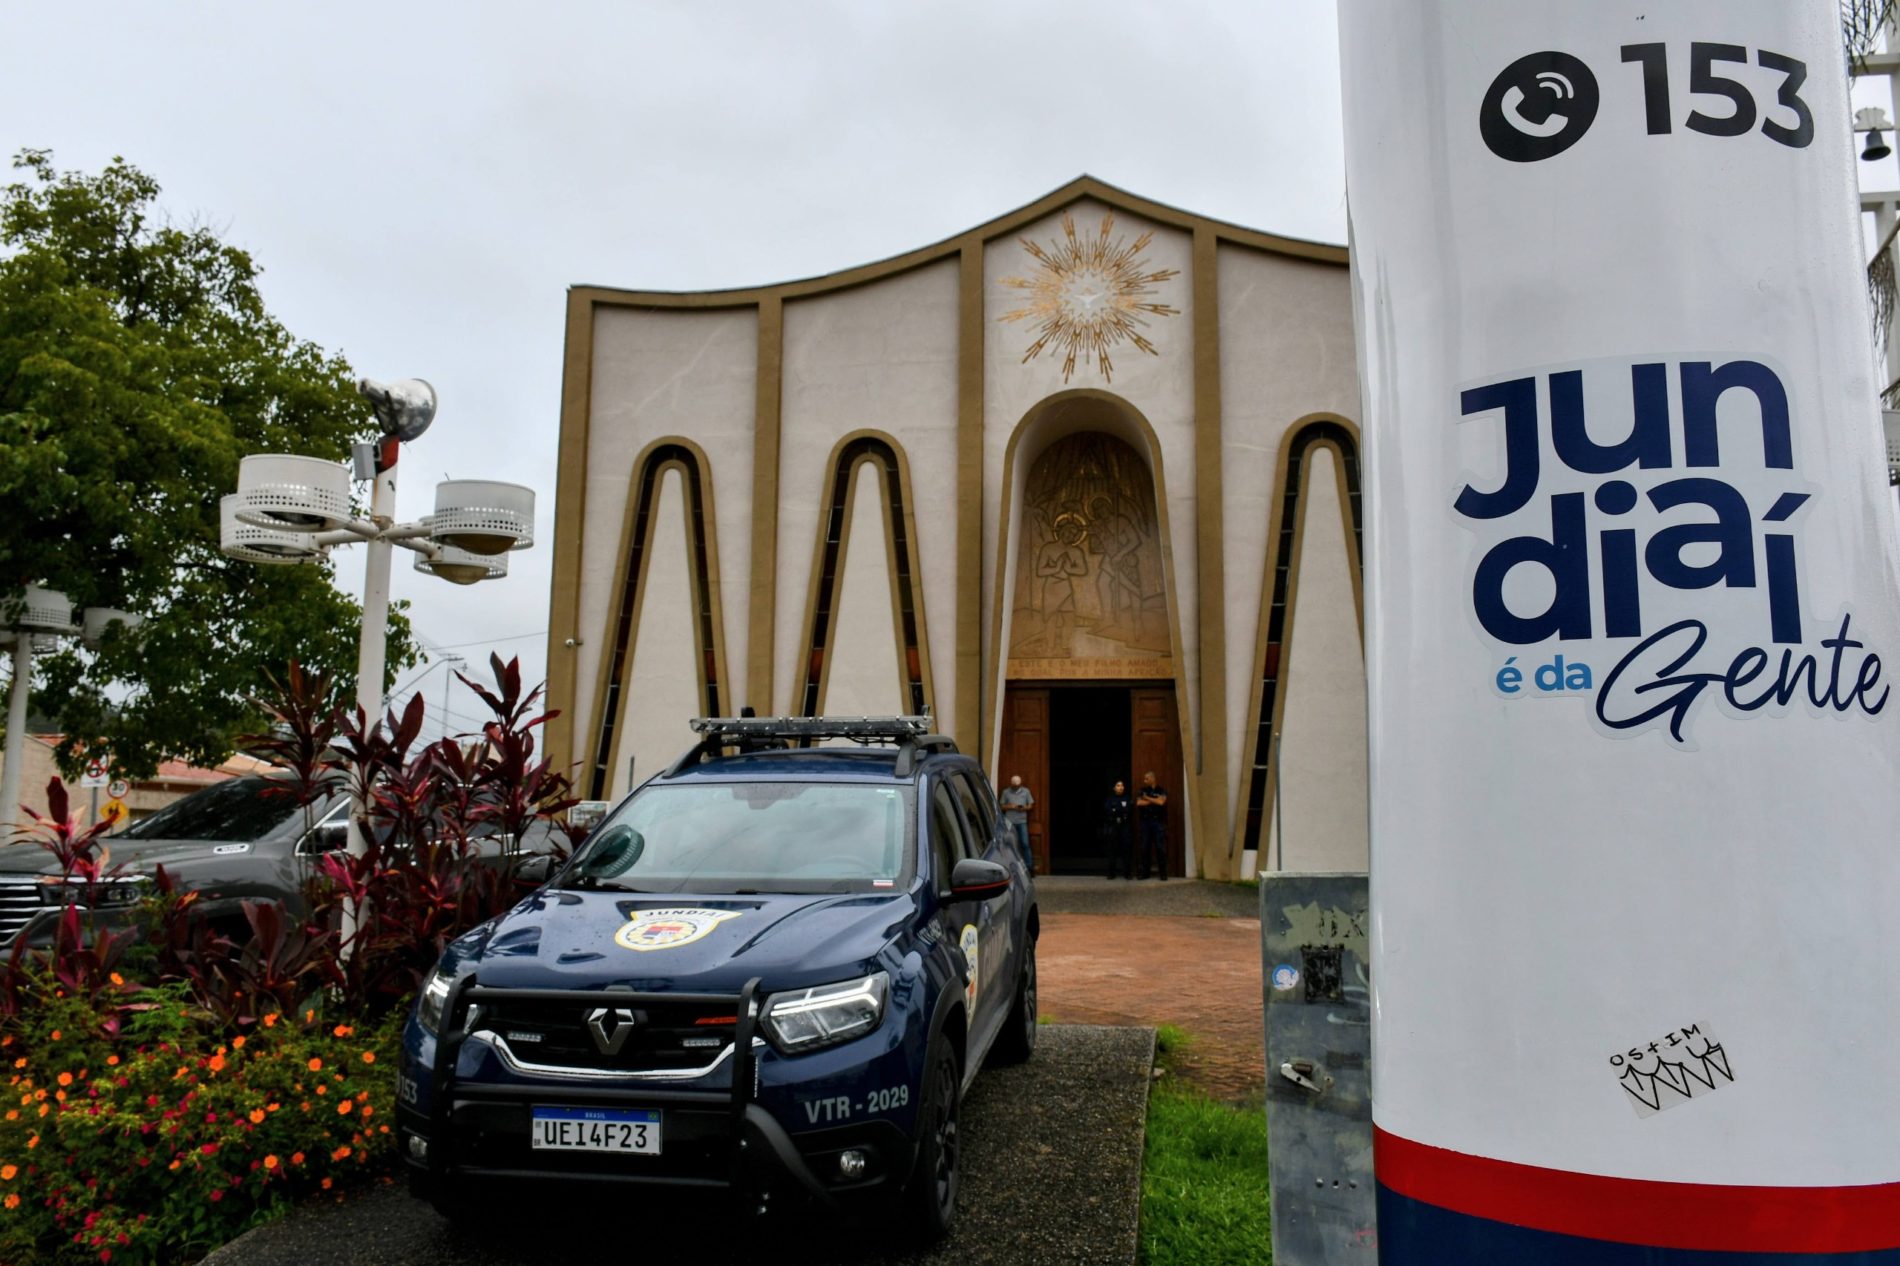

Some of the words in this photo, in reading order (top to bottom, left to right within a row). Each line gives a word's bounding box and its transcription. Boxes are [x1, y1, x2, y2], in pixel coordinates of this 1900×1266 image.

[1620, 42, 1814, 148] 153
[1496, 656, 1522, 693] é
[1534, 654, 1592, 691] da
[1596, 613, 1890, 742] Gente
[544, 1121, 648, 1148] UEI4F23
[804, 1096, 850, 1124] VTR
[867, 1084, 909, 1113] 2029
